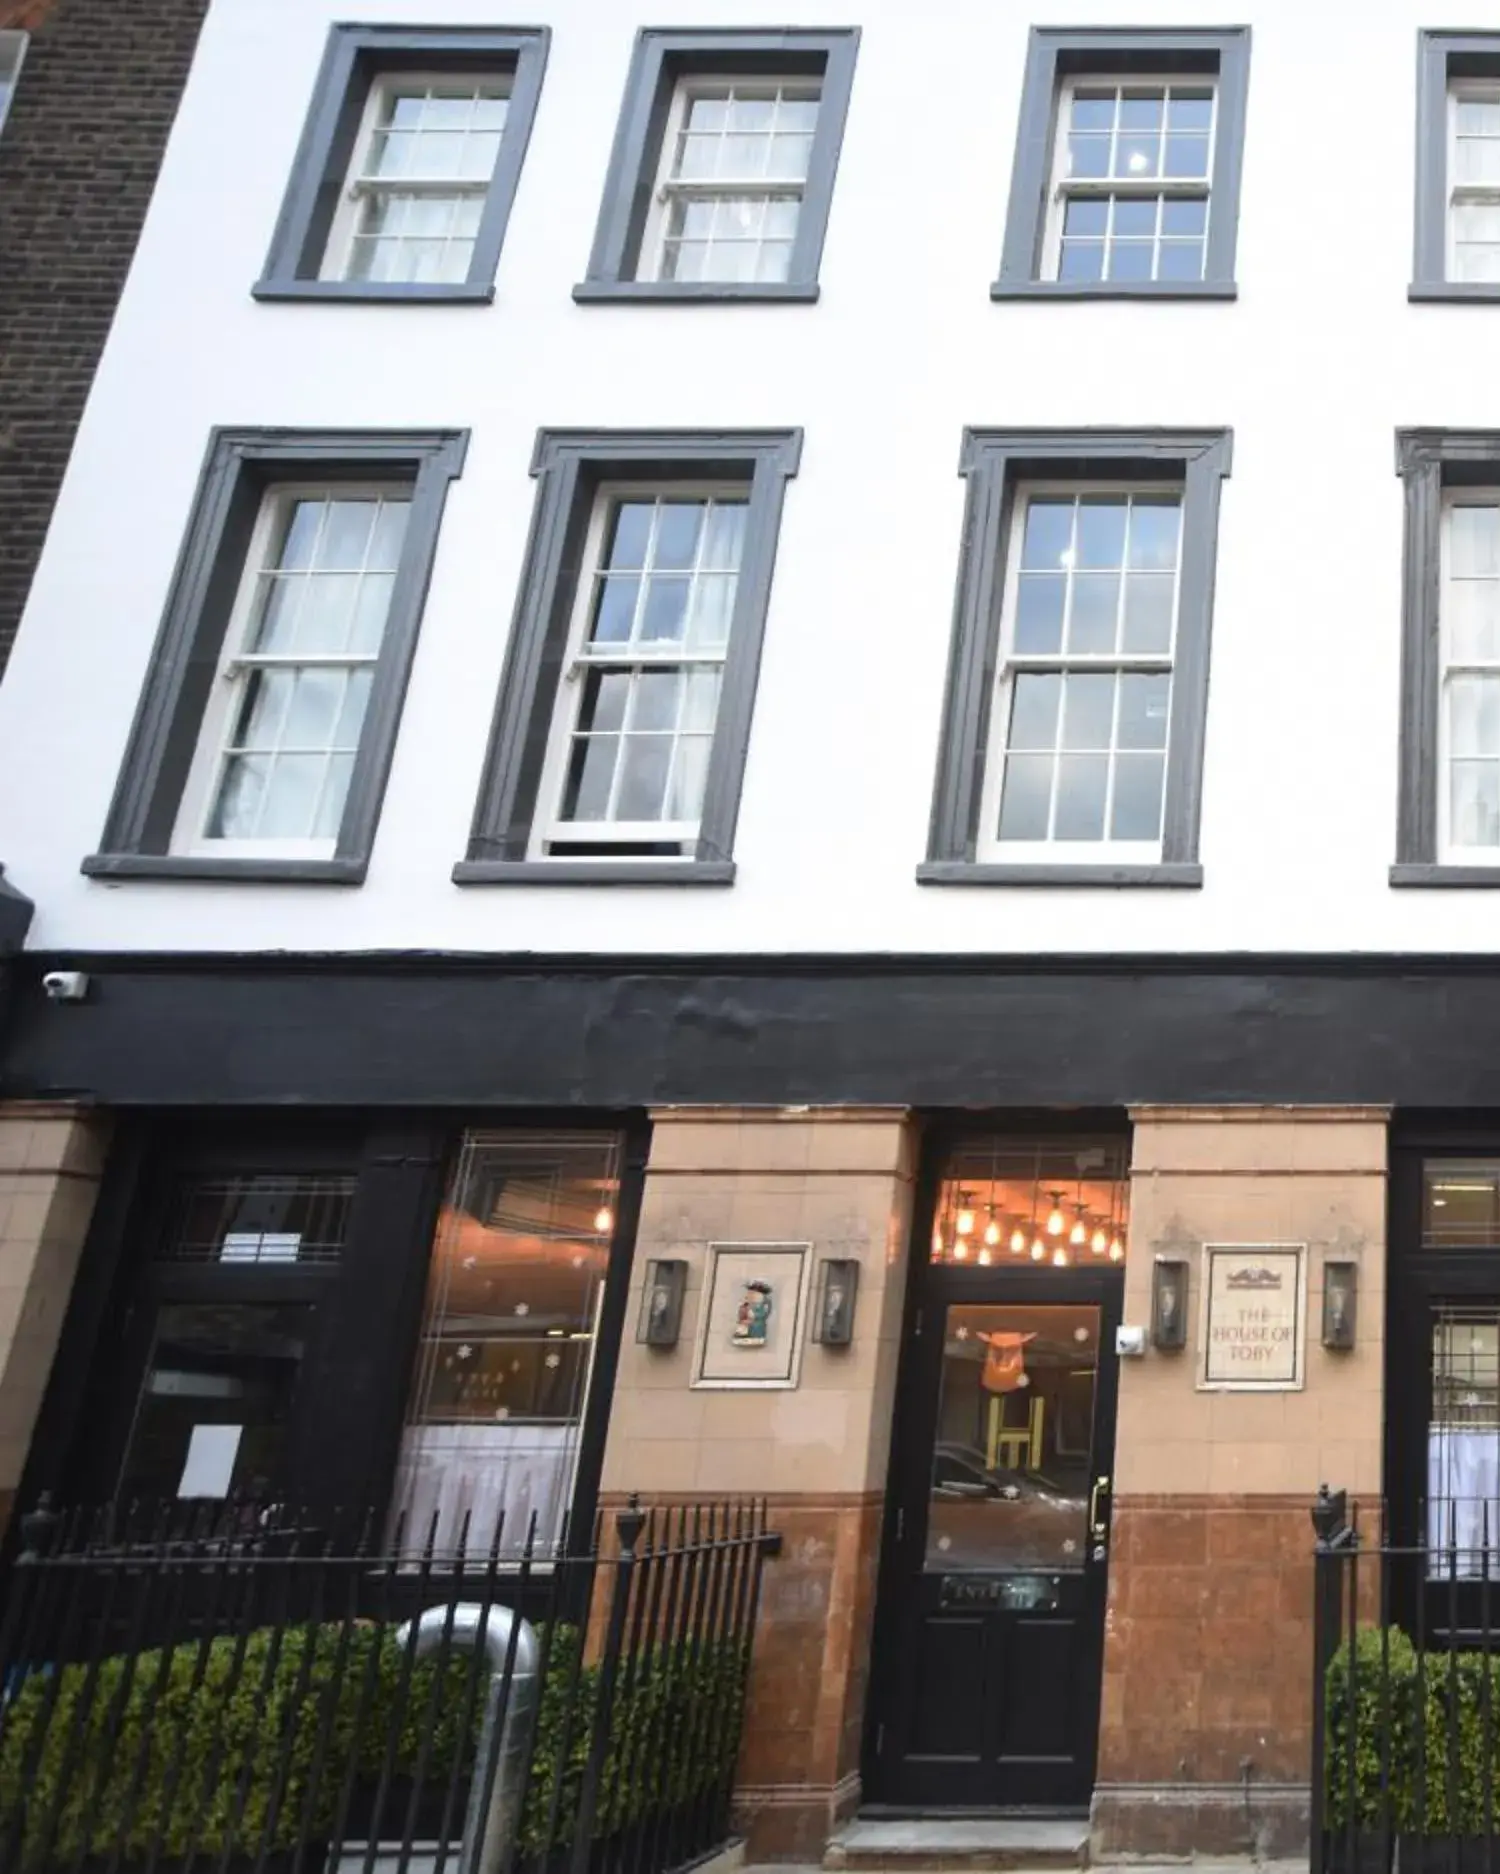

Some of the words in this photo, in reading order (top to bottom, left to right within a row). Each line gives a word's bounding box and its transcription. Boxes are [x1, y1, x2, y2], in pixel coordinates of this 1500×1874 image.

[1237, 1308, 1270, 1323] THE
[1212, 1326, 1268, 1342] HOUSE
[1271, 1326, 1292, 1342] OF
[1230, 1345, 1274, 1362] TOBY
